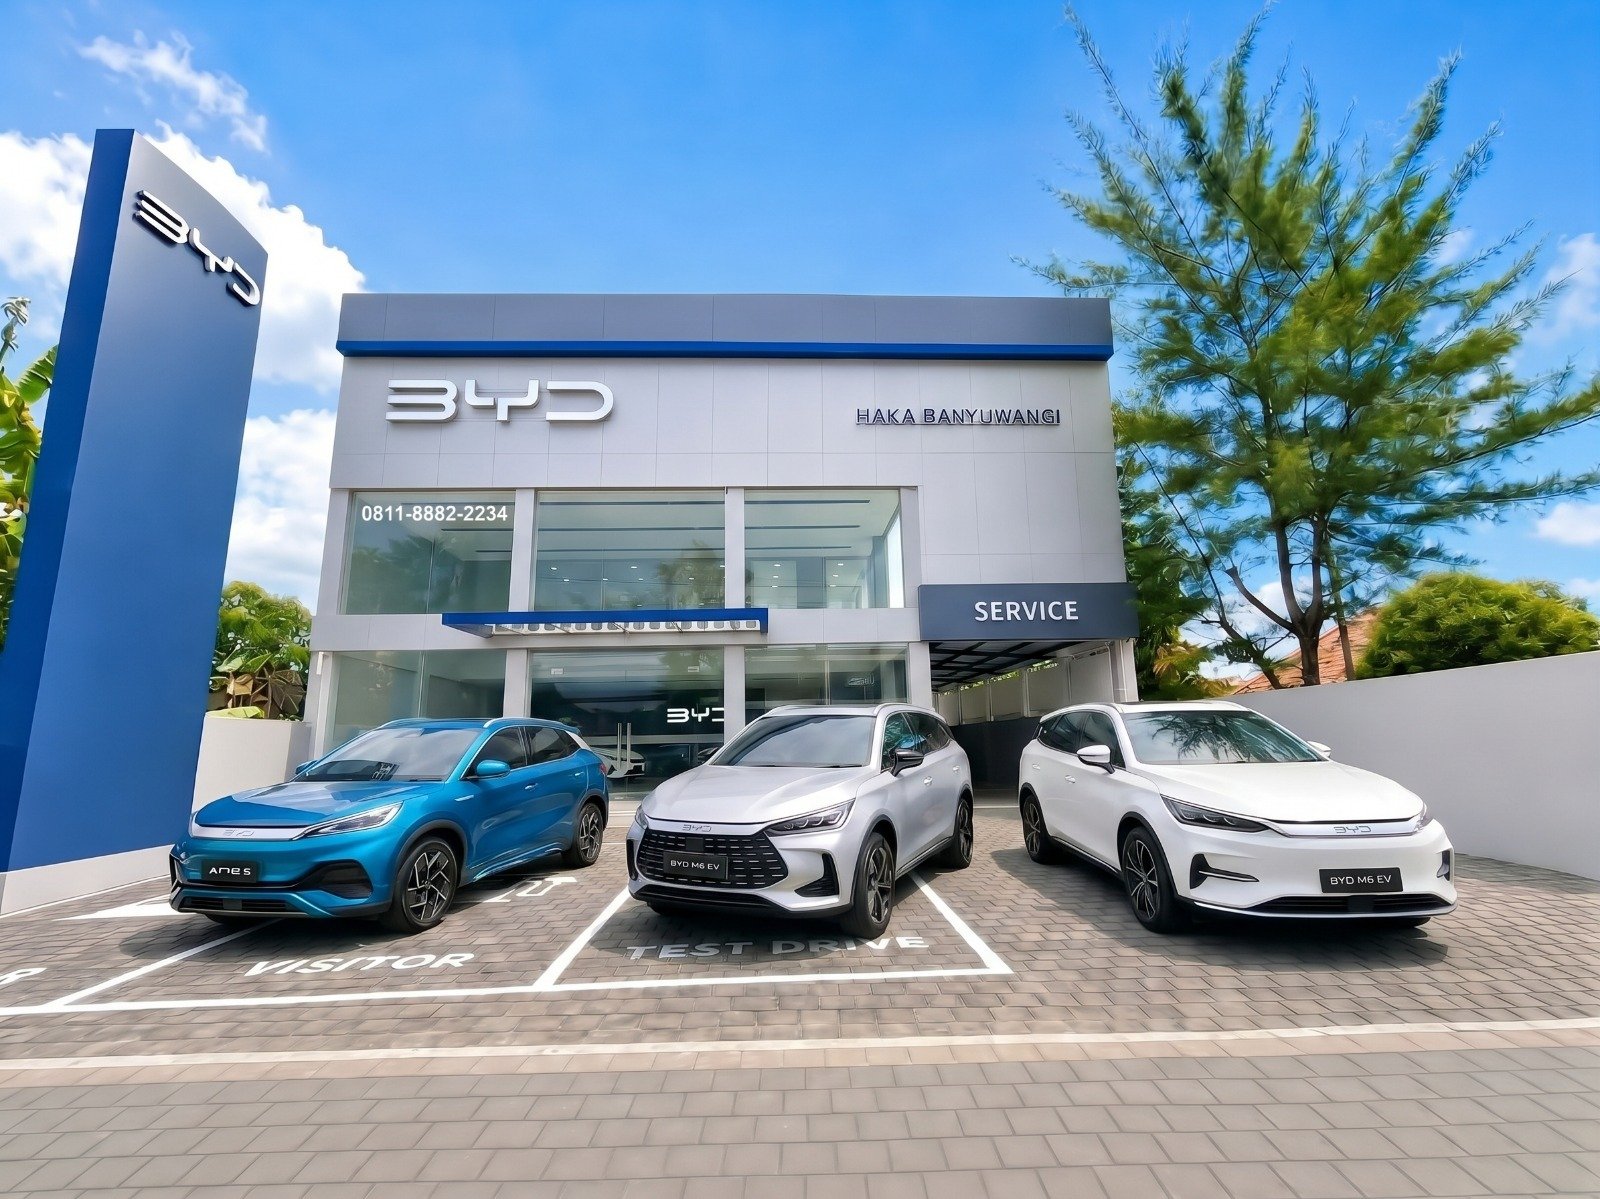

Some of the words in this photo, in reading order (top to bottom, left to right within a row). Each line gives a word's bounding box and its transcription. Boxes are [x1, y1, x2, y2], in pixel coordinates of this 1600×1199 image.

[133, 190, 260, 306] BYD
[386, 379, 614, 423] BYD
[857, 408, 916, 425] HAKA
[923, 408, 1061, 426] BANYUWANGI
[974, 601, 1079, 621] SERVICE
[682, 824, 712, 832] BYD
[1333, 825, 1372, 833] BYD
[670, 860, 689, 868] BYD
[691, 861, 705, 869] M6
[1330, 876, 1355, 885] BYD
[1357, 875, 1374, 884] M6
[1377, 874, 1392, 884] EV
[627, 942, 753, 960] TEST
[772, 936, 930, 955] DRIVE
[244, 953, 475, 977] VISITOR
